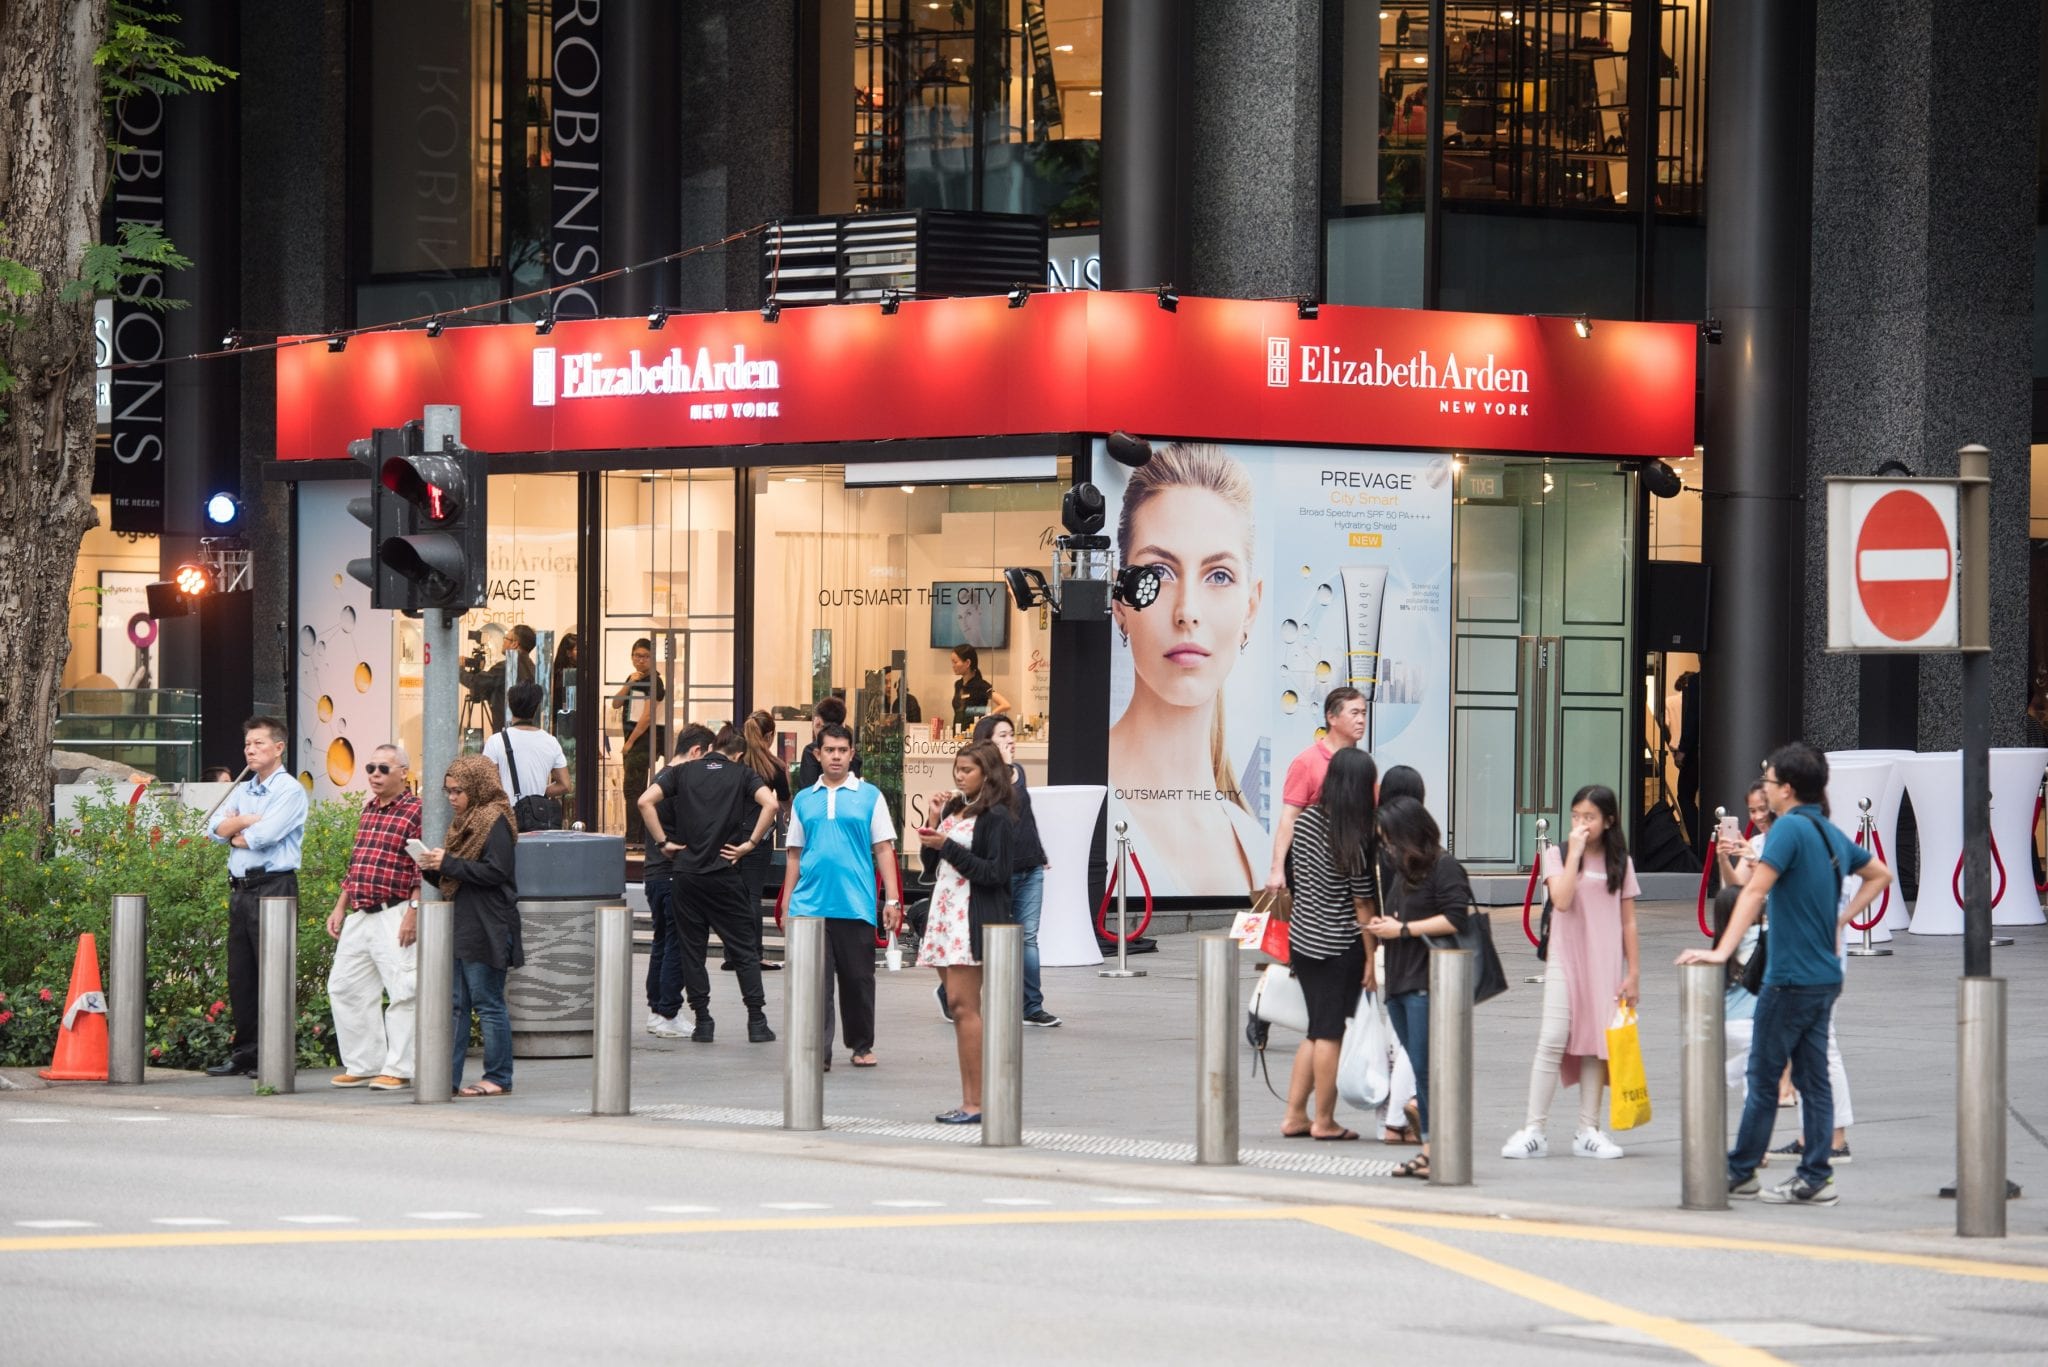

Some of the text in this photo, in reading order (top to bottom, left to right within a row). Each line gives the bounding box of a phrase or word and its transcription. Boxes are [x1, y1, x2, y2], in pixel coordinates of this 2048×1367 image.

[114, 55, 164, 465] OBISONS
[690, 402, 780, 421] NEW YORK
[1440, 400, 1529, 416] NEW YORK
[1321, 470, 1412, 490] PREVAGE
[1330, 491, 1400, 506] City Smart
[1299, 507, 1325, 517] Broad
[1326, 508, 1366, 519] Spectrum
[1367, 510, 1384, 519] SPF
[1386, 511, 1397, 519] 50
[1334, 520, 1397, 531] Hydrating Shield
[1352, 535, 1379, 545] NEW
[818, 587, 997, 607] OUTSMART THE CITY
[459, 608, 525, 625] ity Smart
[1114, 788, 1243, 801] OUTSMART THE CITY
